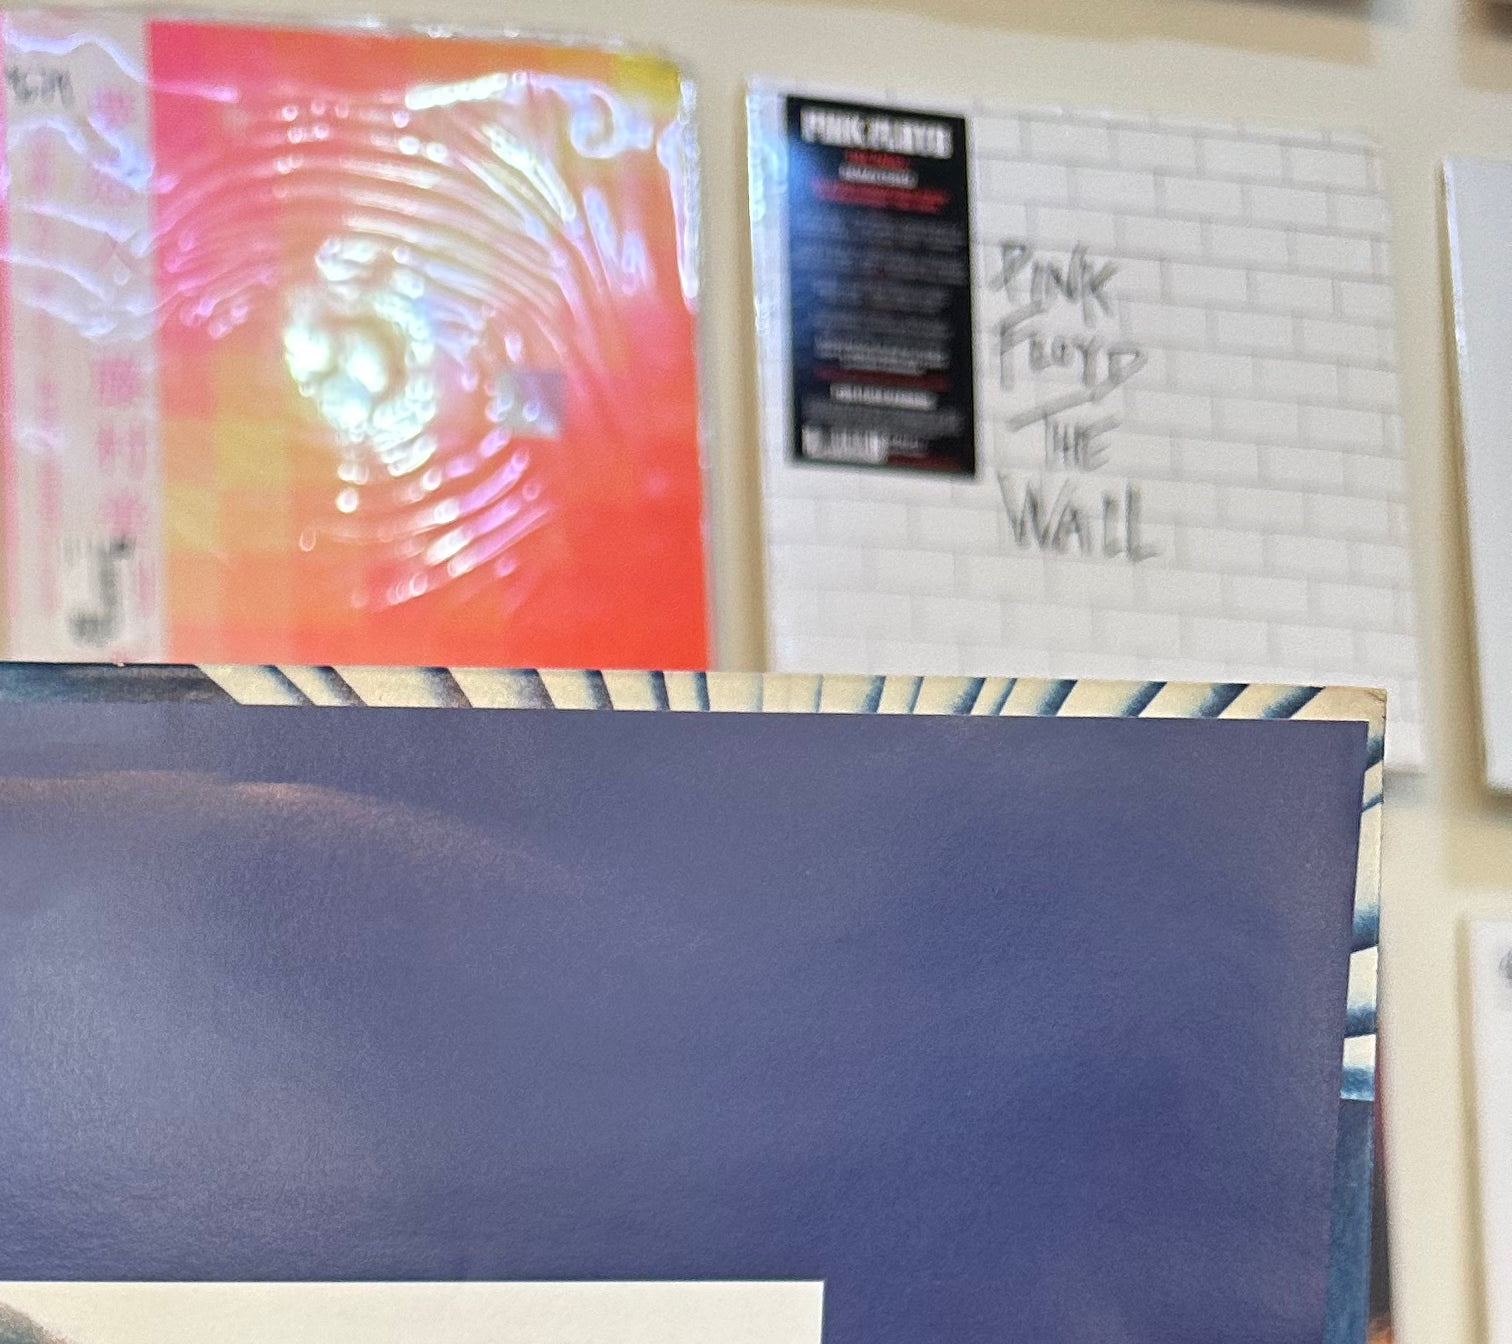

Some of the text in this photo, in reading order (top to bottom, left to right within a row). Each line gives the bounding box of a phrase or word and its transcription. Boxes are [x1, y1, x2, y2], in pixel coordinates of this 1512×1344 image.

[989, 240, 1119, 328] PINK
[991, 302, 1148, 408] FLOYD
[1008, 404, 1122, 473] THE
[996, 475, 1162, 562] WALL
